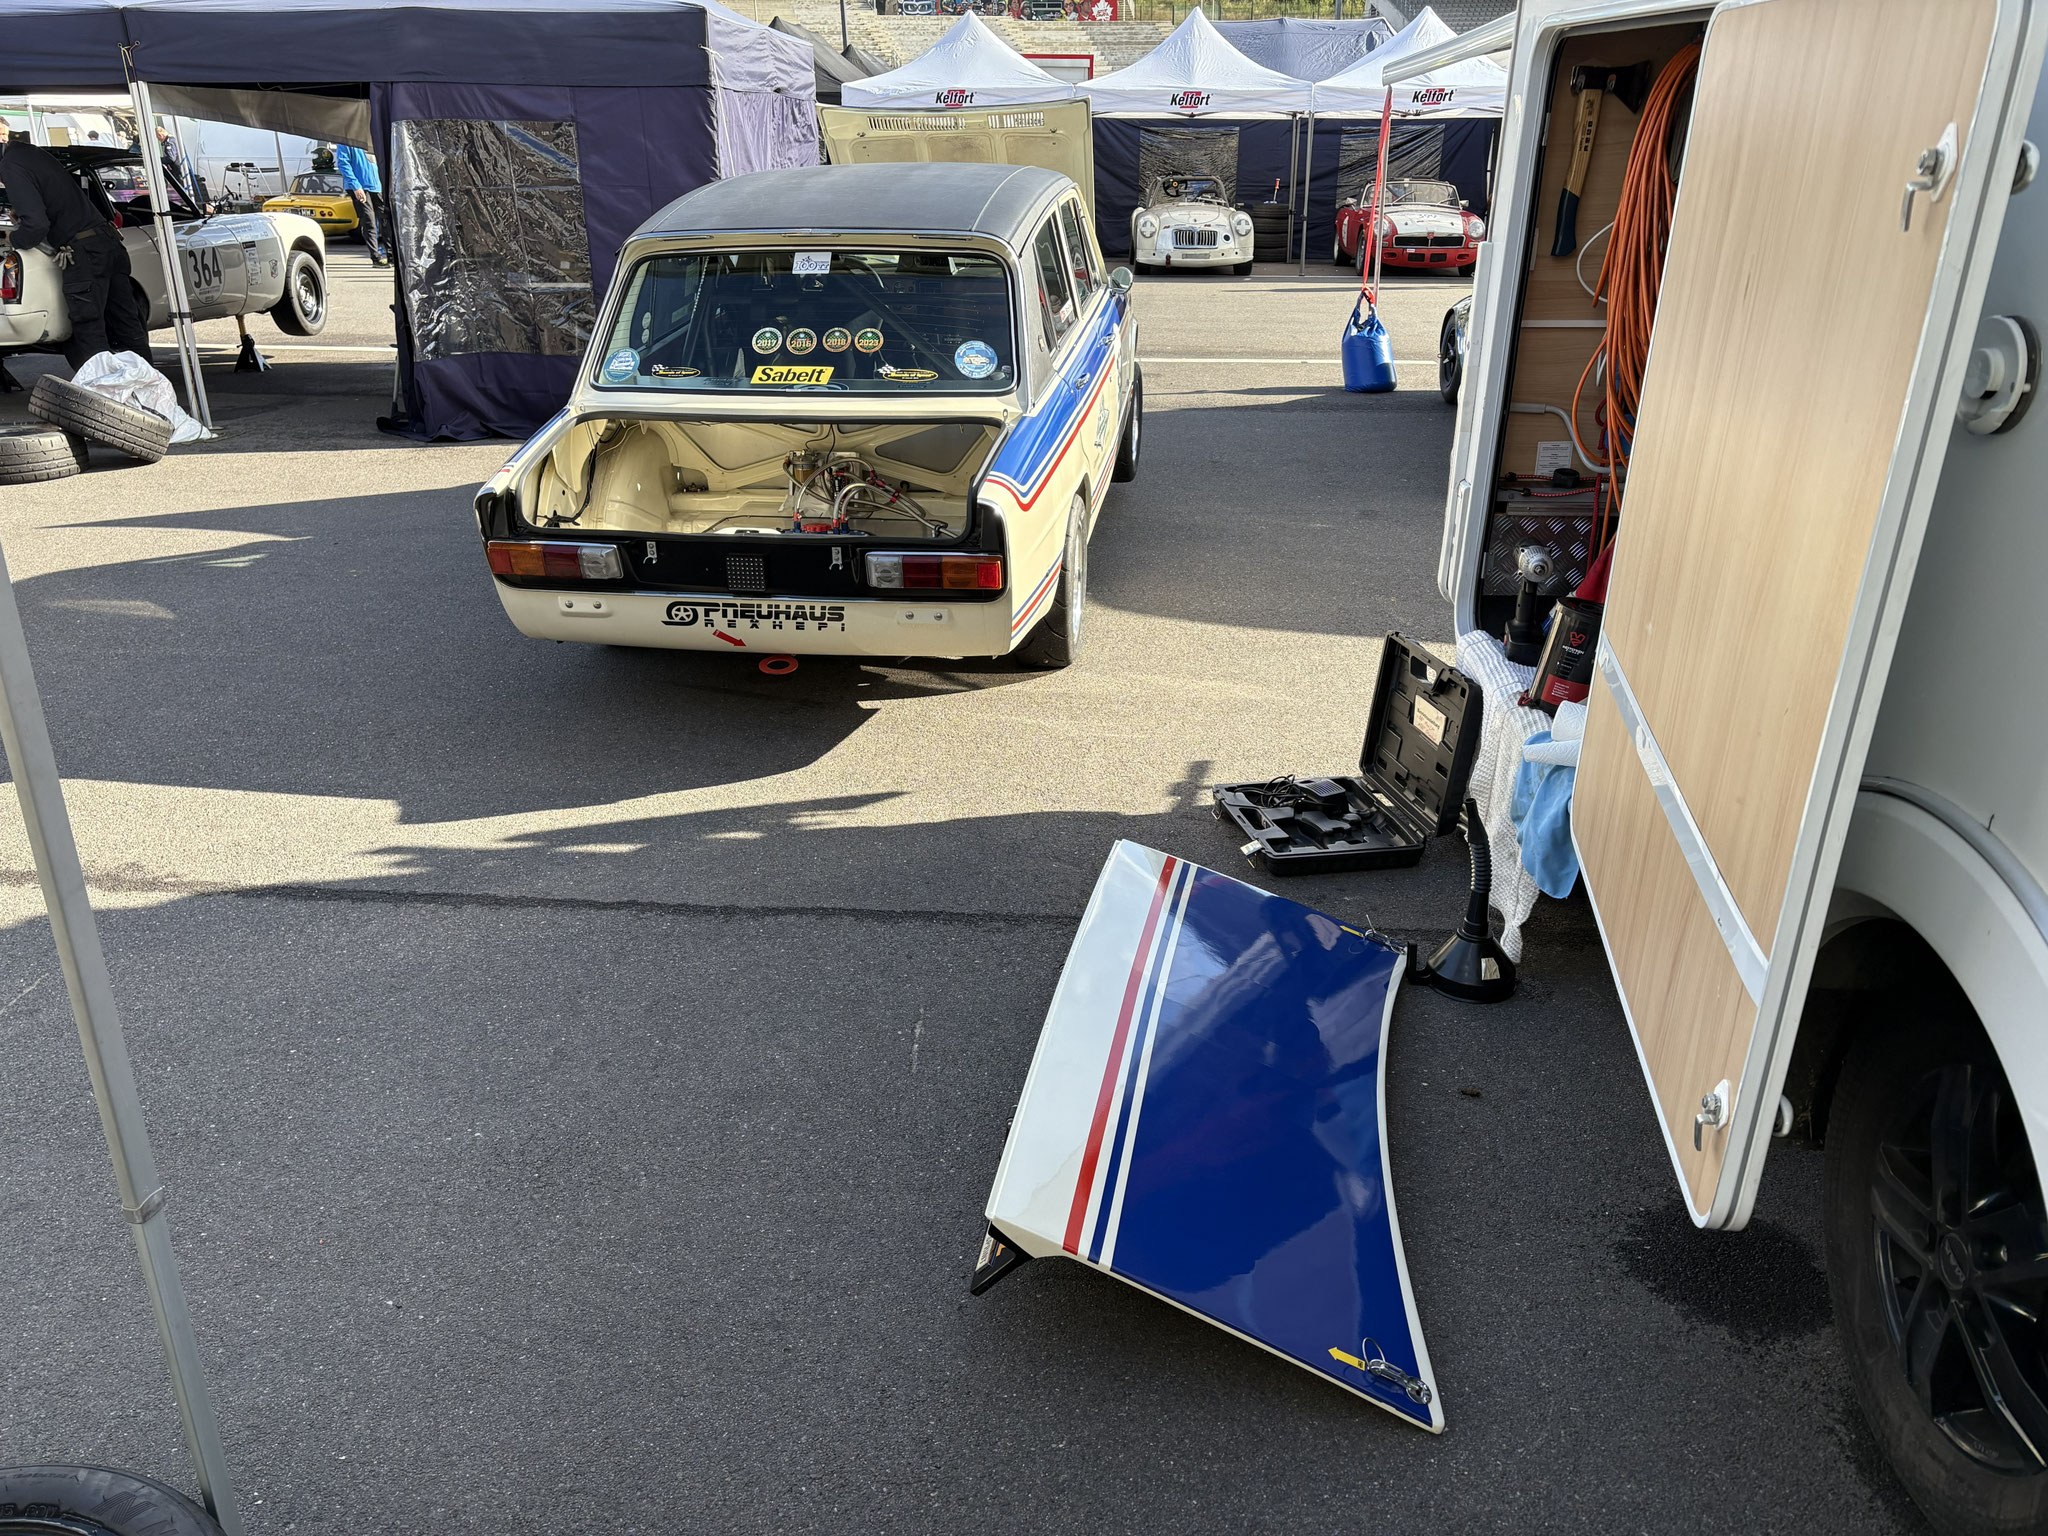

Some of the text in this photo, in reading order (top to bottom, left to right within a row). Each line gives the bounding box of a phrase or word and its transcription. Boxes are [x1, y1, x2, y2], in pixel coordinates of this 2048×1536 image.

[935, 91, 975, 104] Kelfort
[1170, 93, 1211, 106] Kelfort
[1412, 89, 1455, 103] Kelfort
[188, 247, 222, 289] 364
[757, 339, 777, 347] 2017
[758, 367, 826, 383] Sabelt
[703, 602, 845, 622] PNEUHAUS
